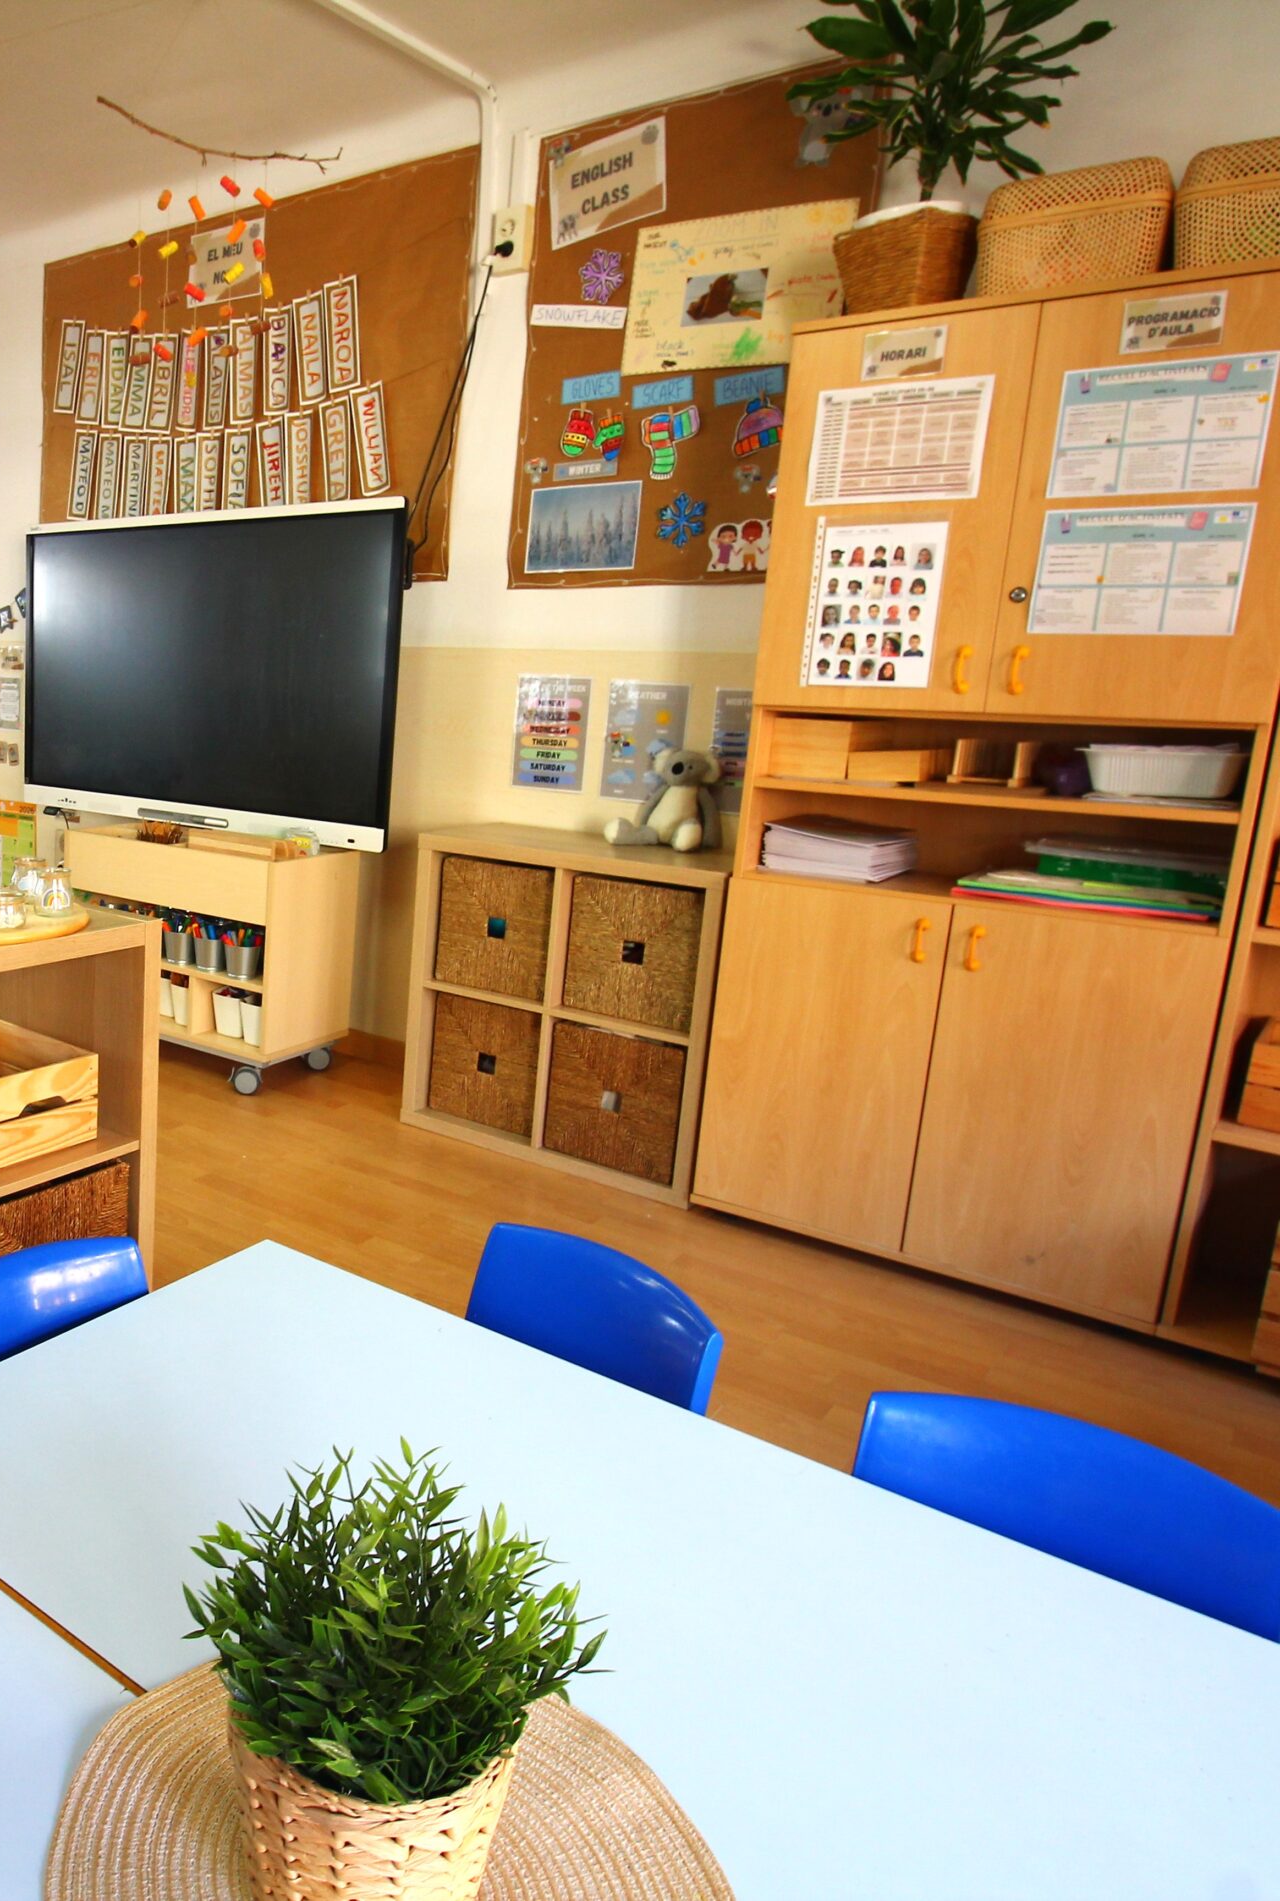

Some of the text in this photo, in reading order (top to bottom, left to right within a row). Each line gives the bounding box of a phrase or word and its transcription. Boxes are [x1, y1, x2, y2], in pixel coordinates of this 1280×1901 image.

[571, 151, 633, 190] ENGLISH
[581, 184, 629, 215] CLASS
[207, 249, 219, 262] EL
[333, 290, 352, 382] NAROA
[535, 307, 624, 326] SNOWFLAKE
[1147, 323, 1195, 339] D'AULA
[271, 318, 286, 406] BIANCA
[302, 312, 321, 387] NAILA
[880, 346, 928, 362] HORARI
[83, 352, 100, 404] ERIC
[110, 346, 125, 414] EIDAN
[128, 362, 149, 416] MMA
[151, 358, 171, 421] BRIL
[210, 336, 225, 420] ALANIS
[239, 329, 254, 414] ALMAS
[572, 375, 615, 400] GLOVES
[723, 372, 775, 399] BEANIE
[642, 378, 685, 406] SCARF
[102, 442, 114, 499] MATEO
[263, 442, 281, 502] JIREH
[327, 410, 345, 500] GRETA
[568, 463, 601, 477] WINTER
[75, 439, 92, 511] MATEO D
[532, 737, 568, 747] THURSDAY
[536, 750, 562, 760] FRIDAY
[530, 762, 567, 772] SATURDAY
[533, 775, 560, 784] SUNDAY
